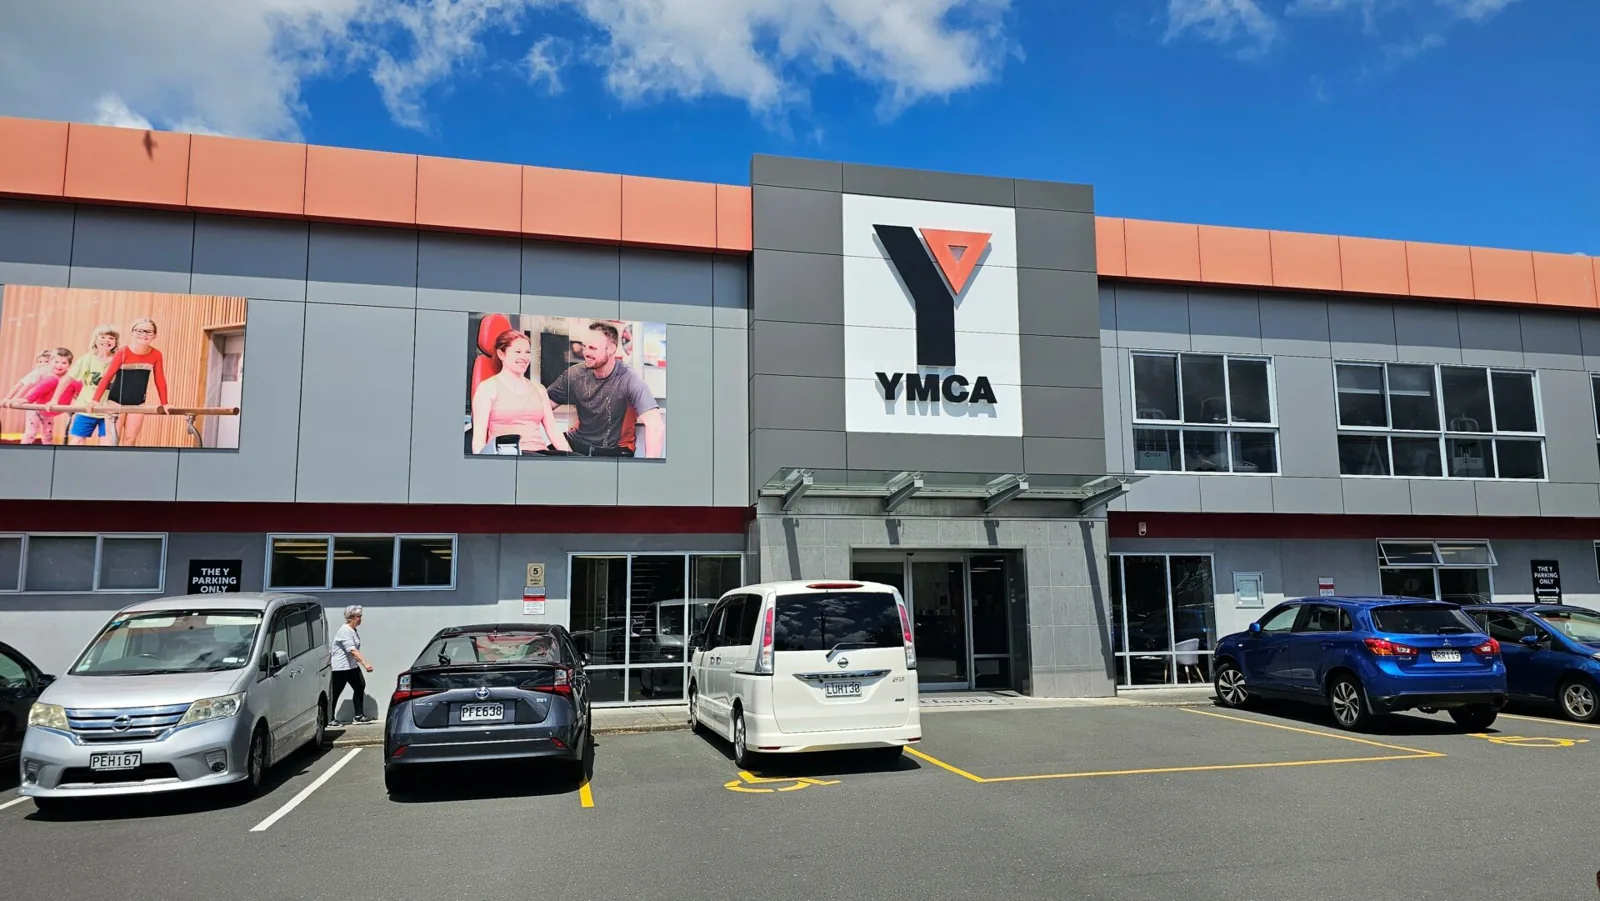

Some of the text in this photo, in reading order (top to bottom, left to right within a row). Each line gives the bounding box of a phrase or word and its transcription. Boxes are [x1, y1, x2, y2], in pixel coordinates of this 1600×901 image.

[875, 372, 998, 404] YMCA
[201, 567, 230, 576] THE Y
[533, 567, 539, 575] 5
[192, 576, 237, 585] PARKING
[200, 585, 228, 593] ONLY
[461, 705, 503, 717] PFE638
[92, 754, 139, 768] PEH167
